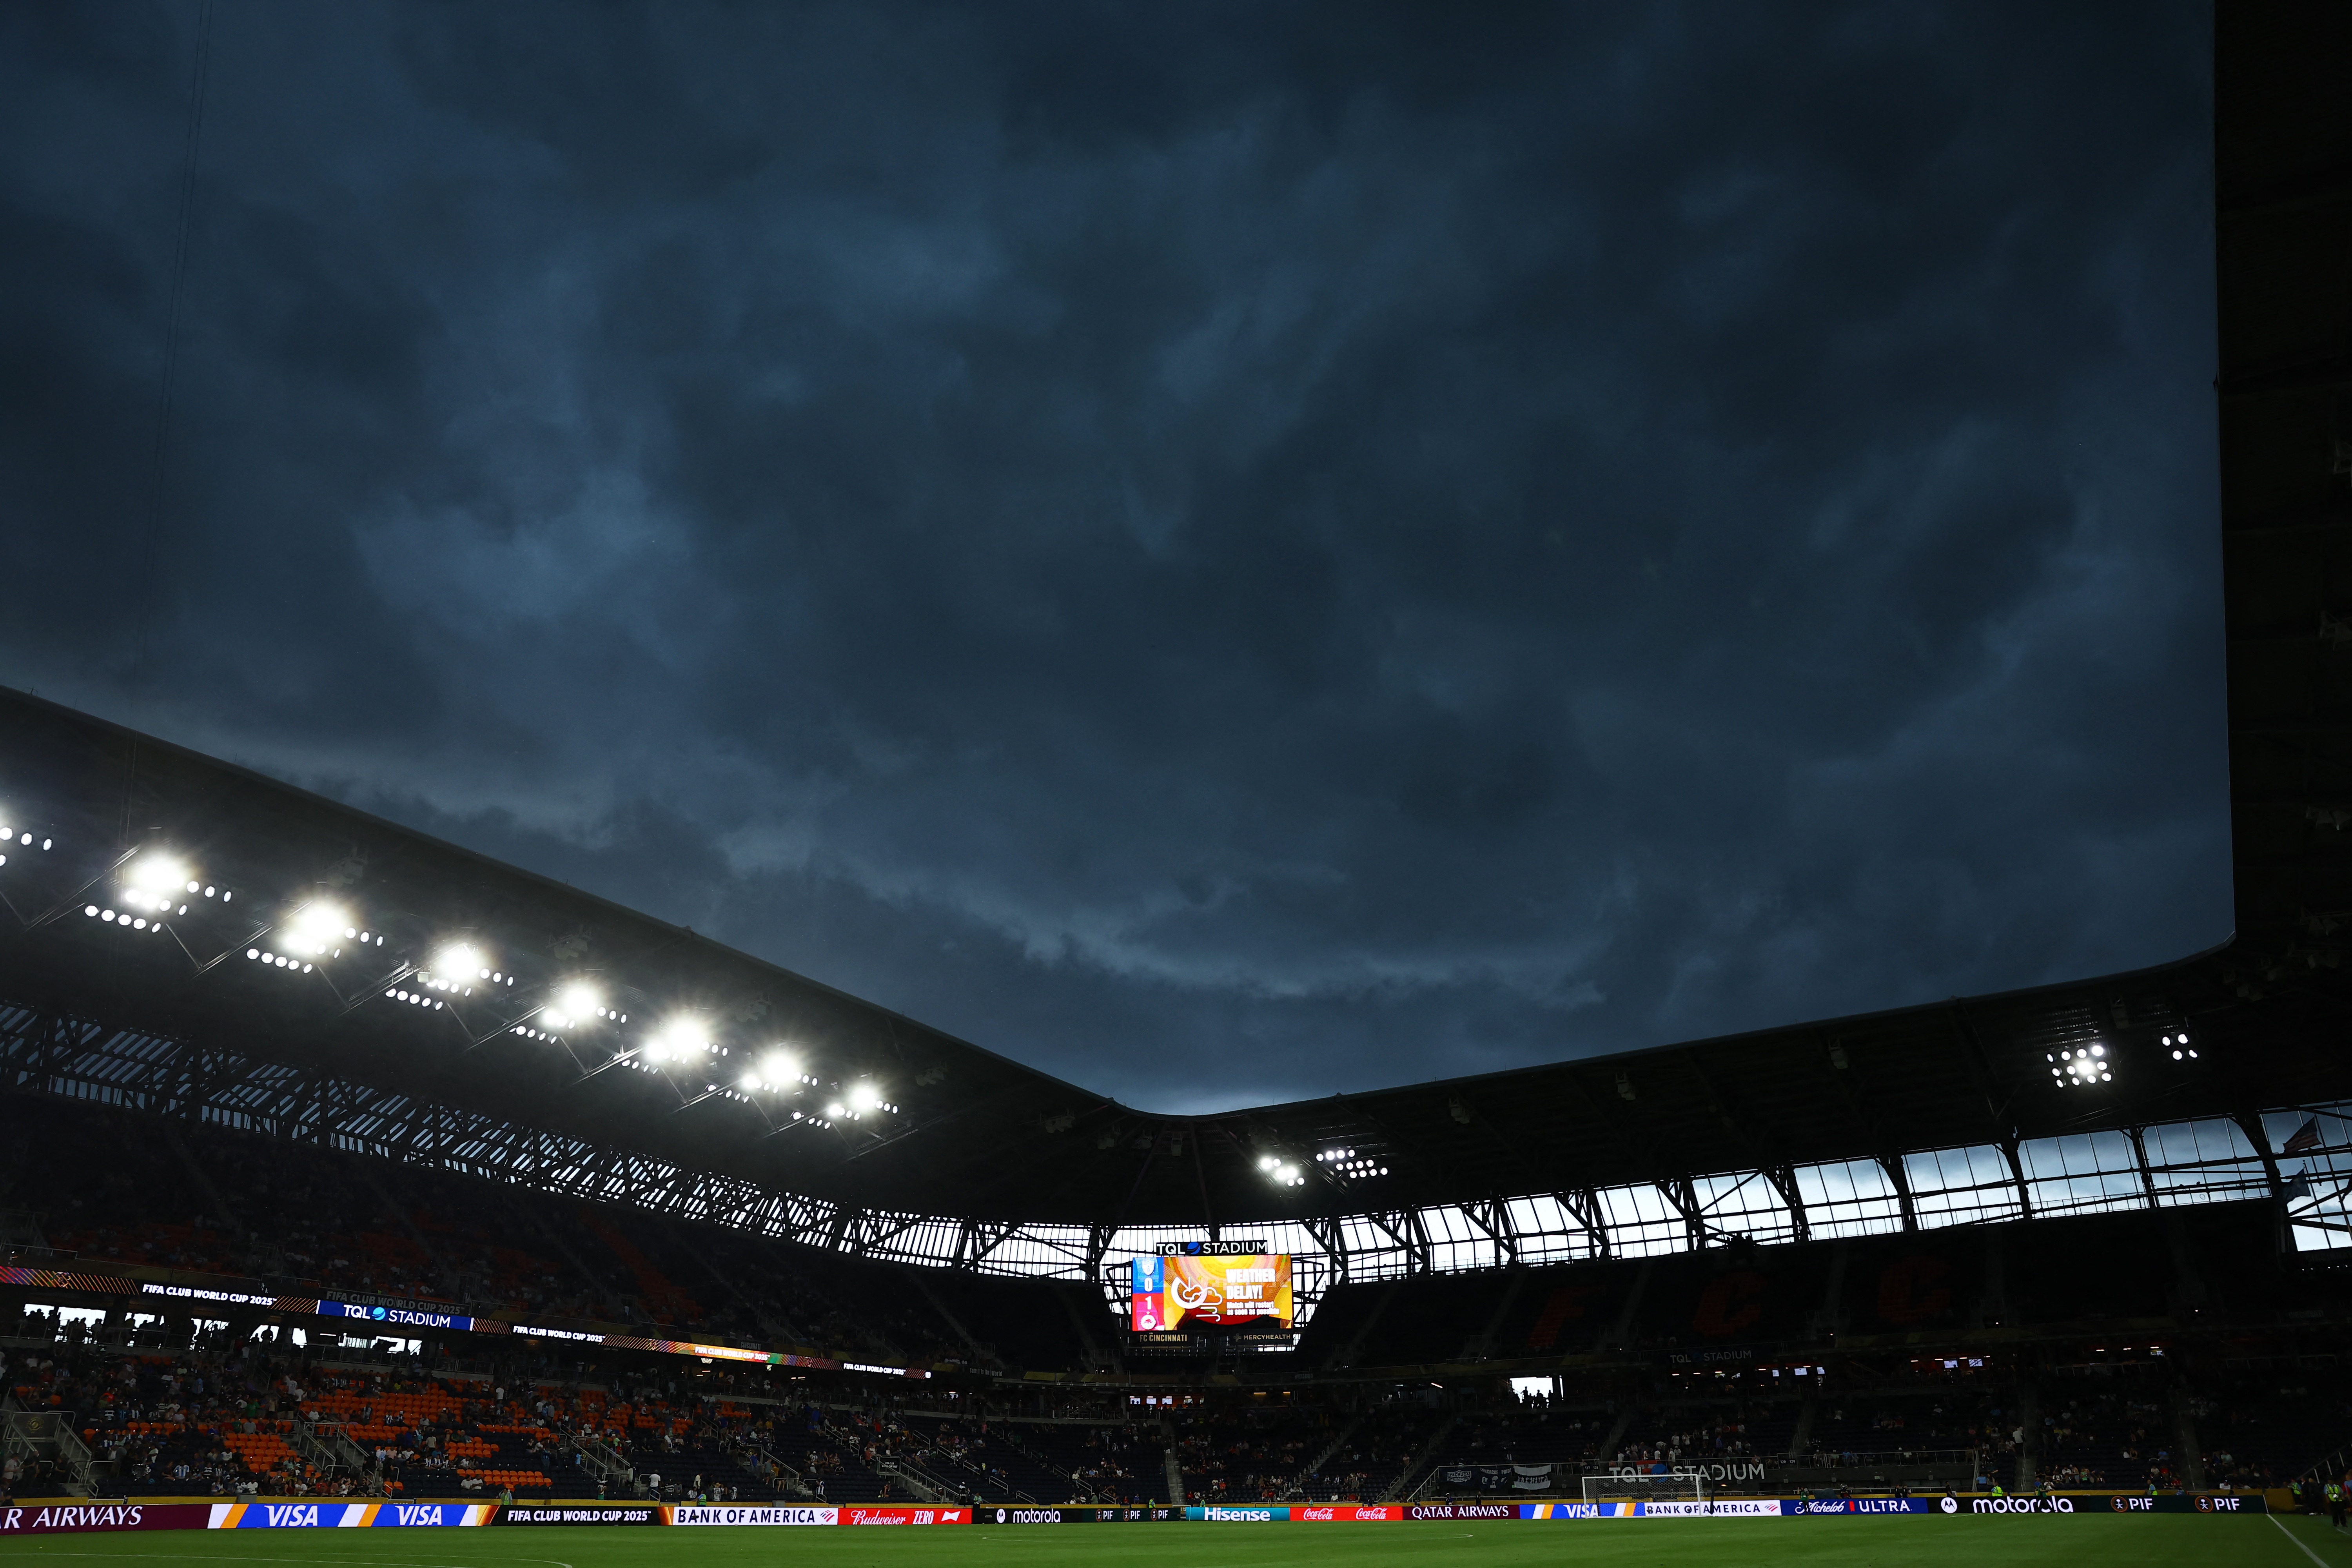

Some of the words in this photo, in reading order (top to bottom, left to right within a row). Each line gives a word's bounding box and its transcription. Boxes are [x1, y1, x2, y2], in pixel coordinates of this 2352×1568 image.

[1156, 1243, 1185, 1255] TQL
[1203, 1241, 1267, 1254] STADIUM
[1226, 1269, 1276, 1283] WEATHER
[1144, 1278, 1153, 1292] 0
[1226, 1285, 1263, 1299] DELAY!
[142, 1284, 164, 1294] FIFA
[166, 1287, 192, 1297] CLUB
[194, 1289, 228, 1301] WORLD
[229, 1294, 249, 1303] CUP
[326, 1291, 347, 1302] FIFA
[350, 1294, 375, 1305] CLUB
[378, 1297, 416, 1309] WORLD
[417, 1301, 436, 1312] CUP
[1145, 1296, 1152, 1310] 1
[343, 1304, 371, 1319] TQL
[388, 1309, 451, 1328] STADIUM
[513, 1326, 528, 1334] FIFA
[529, 1328, 546, 1336] CLUB
[548, 1330, 572, 1339] WORLD
[740, 1341, 761, 1350] CINCINNATI
[723, 1349, 742, 1358] WORLD
[1670, 1354, 1691, 1363] TQL
[1704, 1350, 1752, 1361] STADIUM
[1609, 1466, 1648, 1483] TQL
[1673, 1463, 1765, 1481] STADIUM
[1647, 1505, 1680, 1514] BANK
[1684, 1505, 1699, 1514] OF
[1703, 1504, 1760, 1513] AMERICA
[1795, 1501, 1845, 1514] Michelob
[1859, 1500, 1911, 1512] ULTRA
[1973, 1495, 2074, 1513] motorola
[2129, 1497, 2153, 1510] PIF
[2214, 1498, 2240, 1510] PIF
[32, 1506, 143, 1528] AIRWAYS
[264, 1505, 319, 1526] VISA
[394, 1505, 443, 1526] VISA
[508, 1510, 531, 1521] FIFA
[533, 1510, 561, 1521] CLUB
[563, 1511, 601, 1521] WORLD
[602, 1511, 622, 1521] CUP
[678, 1509, 721, 1523] BANK
[726, 1510, 745, 1523] OF
[749, 1510, 815, 1523] AMERICA
[851, 1510, 906, 1525] Budweiser
[913, 1510, 934, 1524] ZERO
[1013, 1508, 1060, 1523] motorola
[1103, 1510, 1113, 1520] PIF
[1131, 1510, 1140, 1520] PIF
[1158, 1510, 1168, 1519] PIF
[1204, 1507, 1270, 1521] Hisense
[1303, 1508, 1334, 1520] Coca-Cola
[1356, 1507, 1386, 1520] Coca-Cola
[1412, 1506, 1452, 1520] QATAR
[1458, 1506, 1509, 1517] AIRWAYS
[1563, 1504, 1599, 1518] VISA
